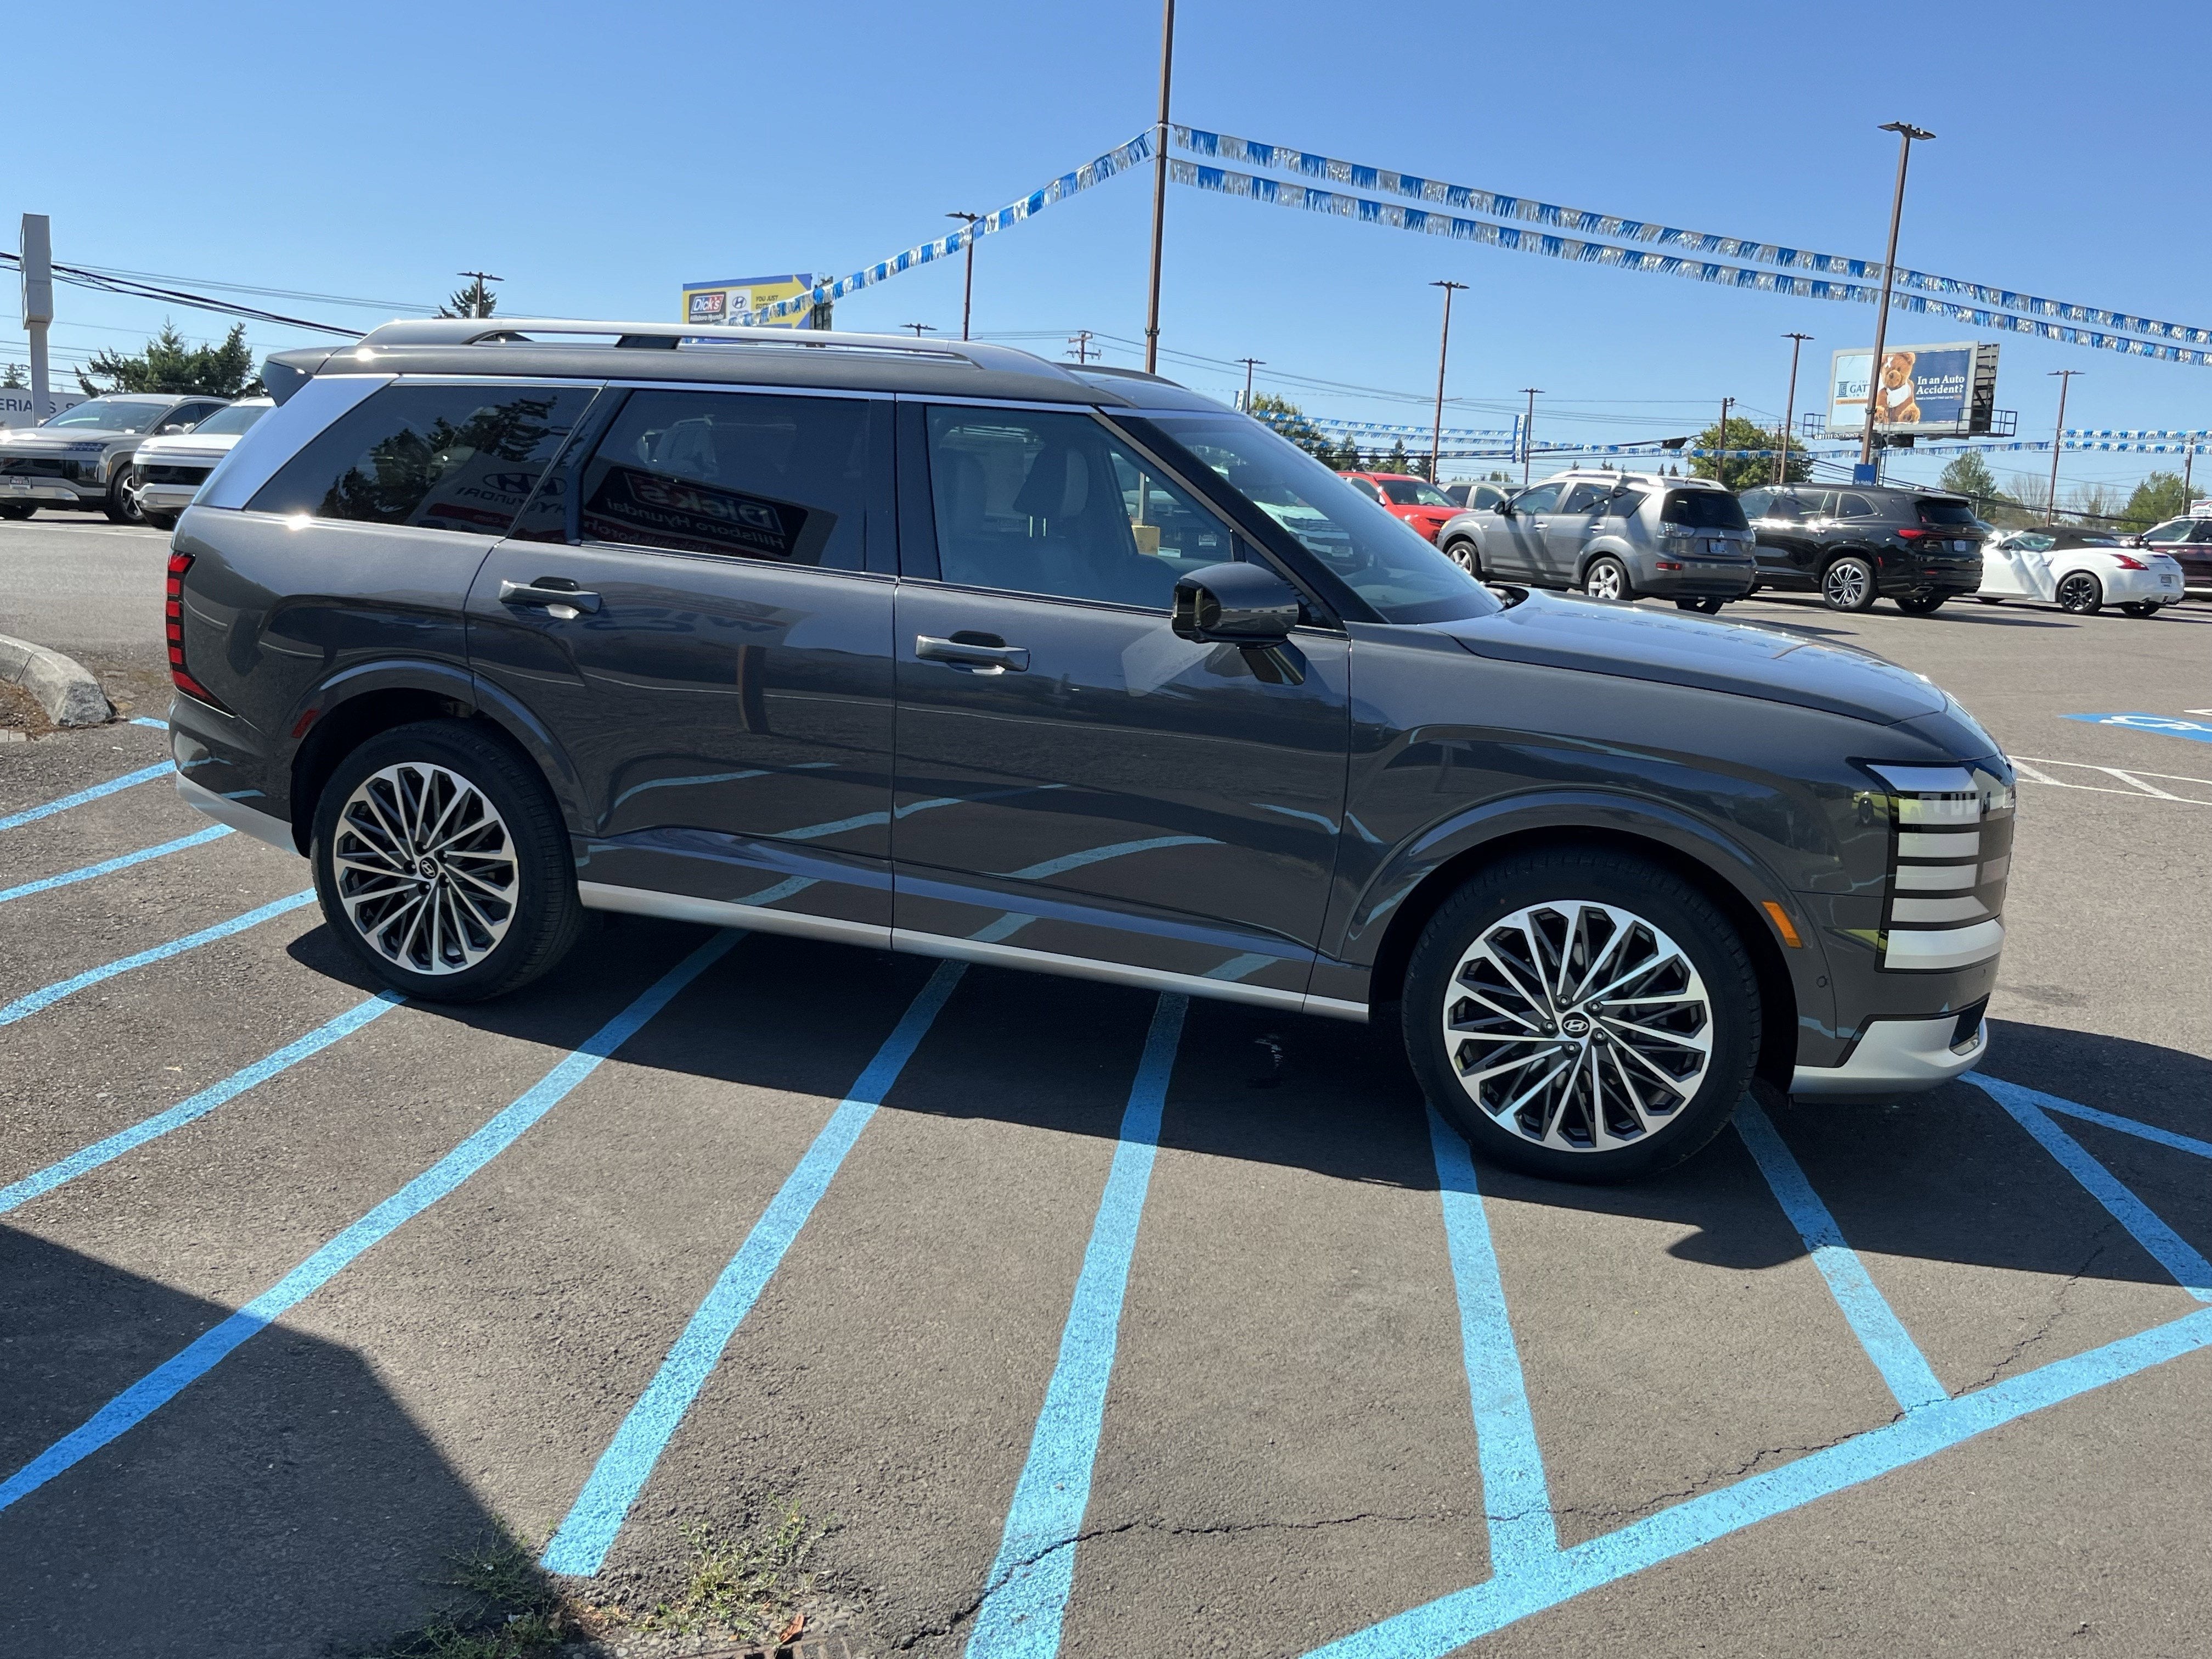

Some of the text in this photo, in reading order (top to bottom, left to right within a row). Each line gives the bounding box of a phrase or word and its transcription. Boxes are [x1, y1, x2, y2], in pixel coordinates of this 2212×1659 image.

[693, 297, 720, 311] Dick's
[1917, 376, 1927, 385] In
[1942, 375, 1965, 383] Auto
[1916, 385, 1963, 394] Accident?
